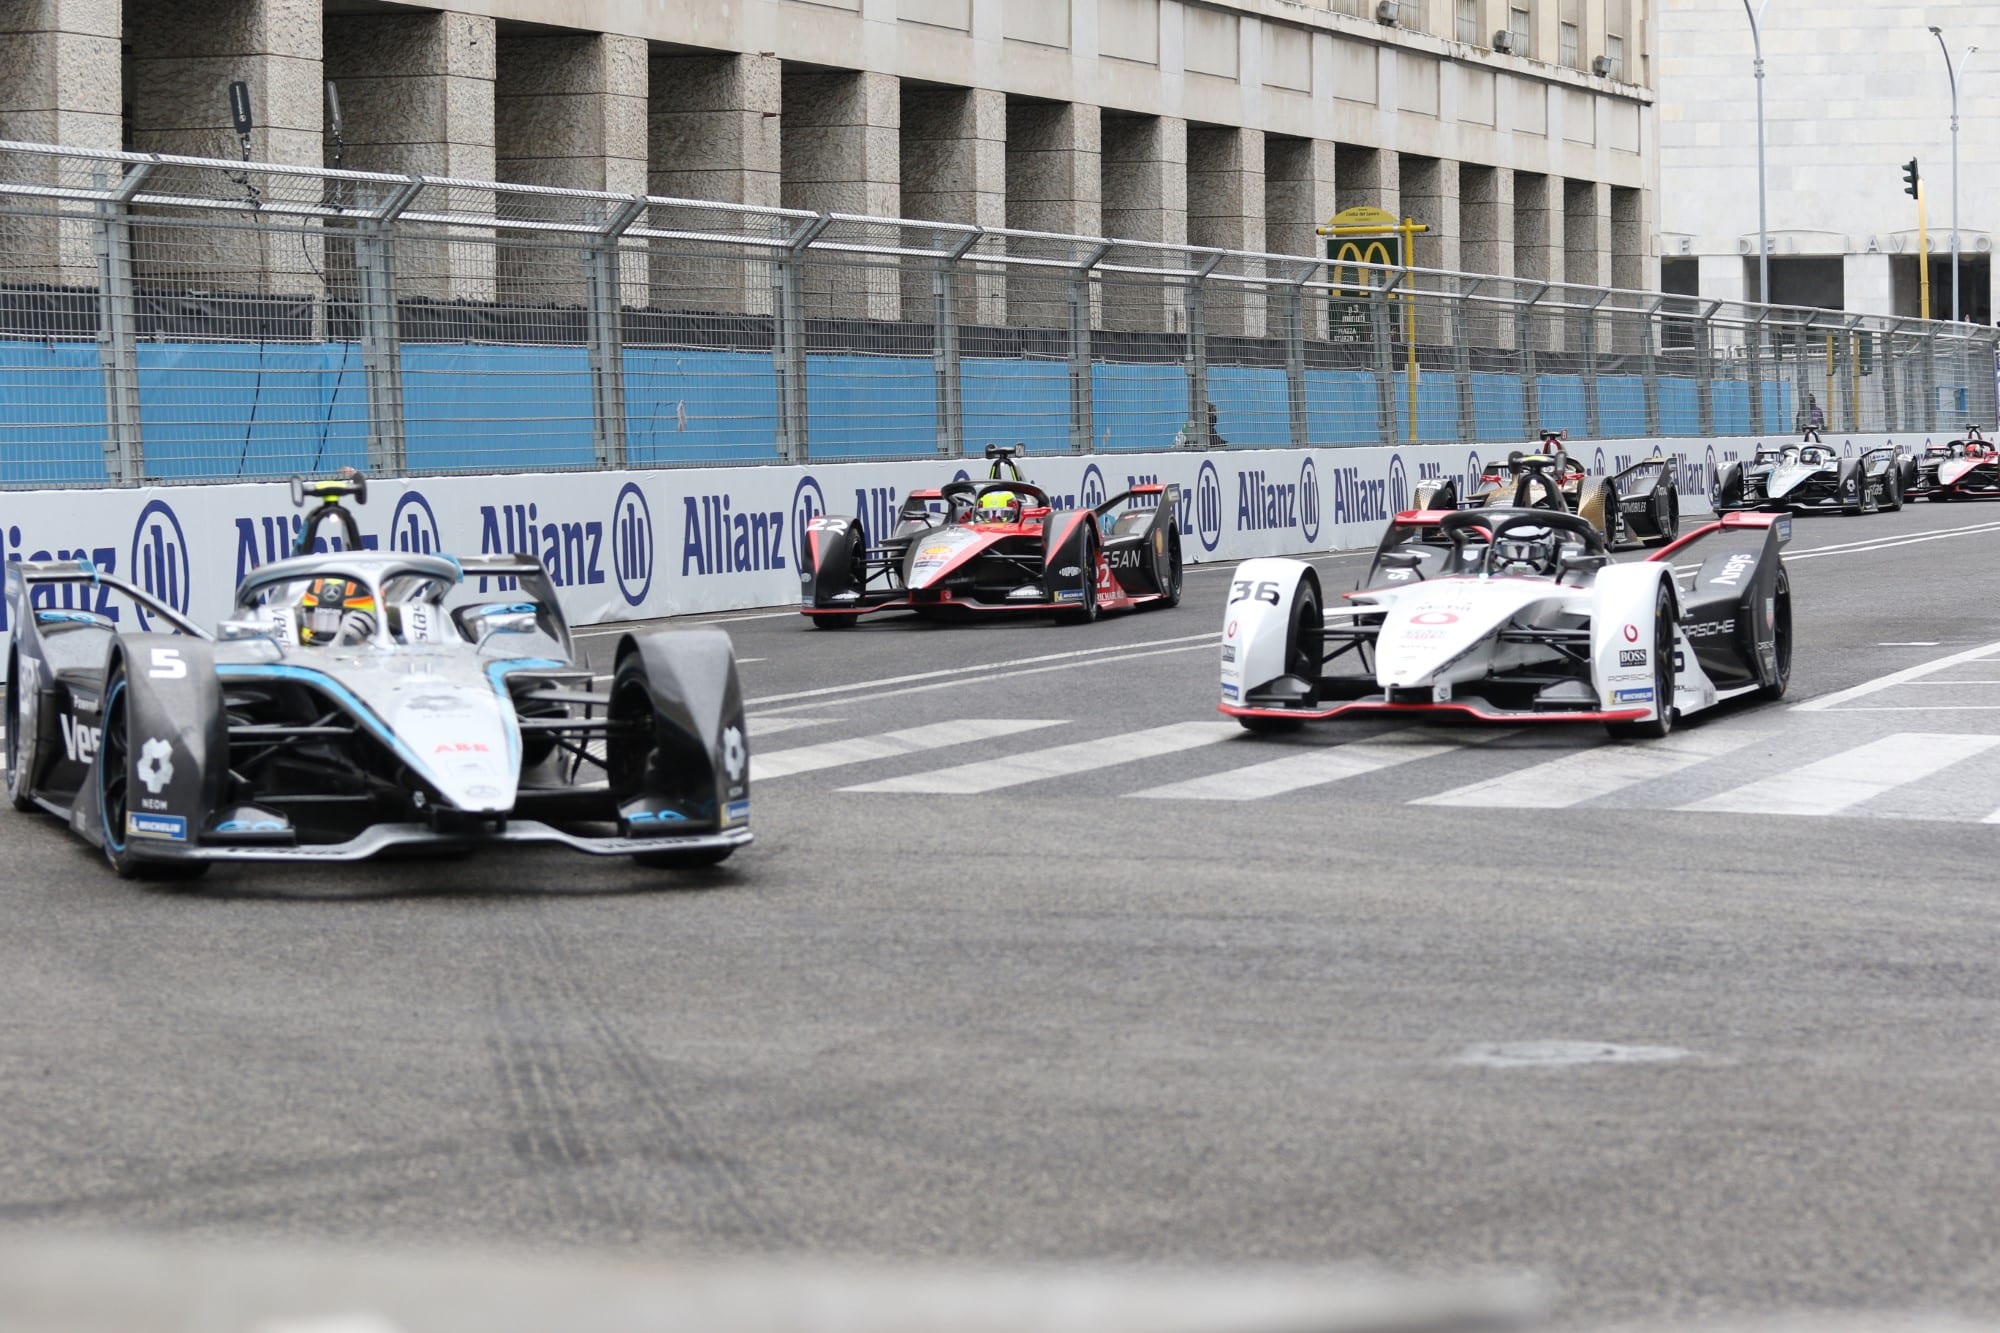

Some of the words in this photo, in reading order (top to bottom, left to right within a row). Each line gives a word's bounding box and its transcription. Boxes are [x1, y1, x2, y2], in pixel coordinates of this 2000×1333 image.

[1737, 236, 1801, 255] DEL
[1127, 474, 1193, 535] Allinz
[1237, 470, 1297, 531] Allianz
[1334, 467, 1387, 525] Allianz
[681, 494, 786, 576] Allianz
[807, 518, 848, 536] 22
[479, 503, 605, 593] Allianz
[1102, 549, 1141, 569] SSAN
[1230, 580, 1281, 606] 36
[1680, 619, 1735, 638] ORSCHE
[149, 649, 187, 679] 5
[1620, 650, 1646, 662] BOSS
[1608, 673, 1653, 682] PORSCH
[142, 797, 168, 811] NEOM
